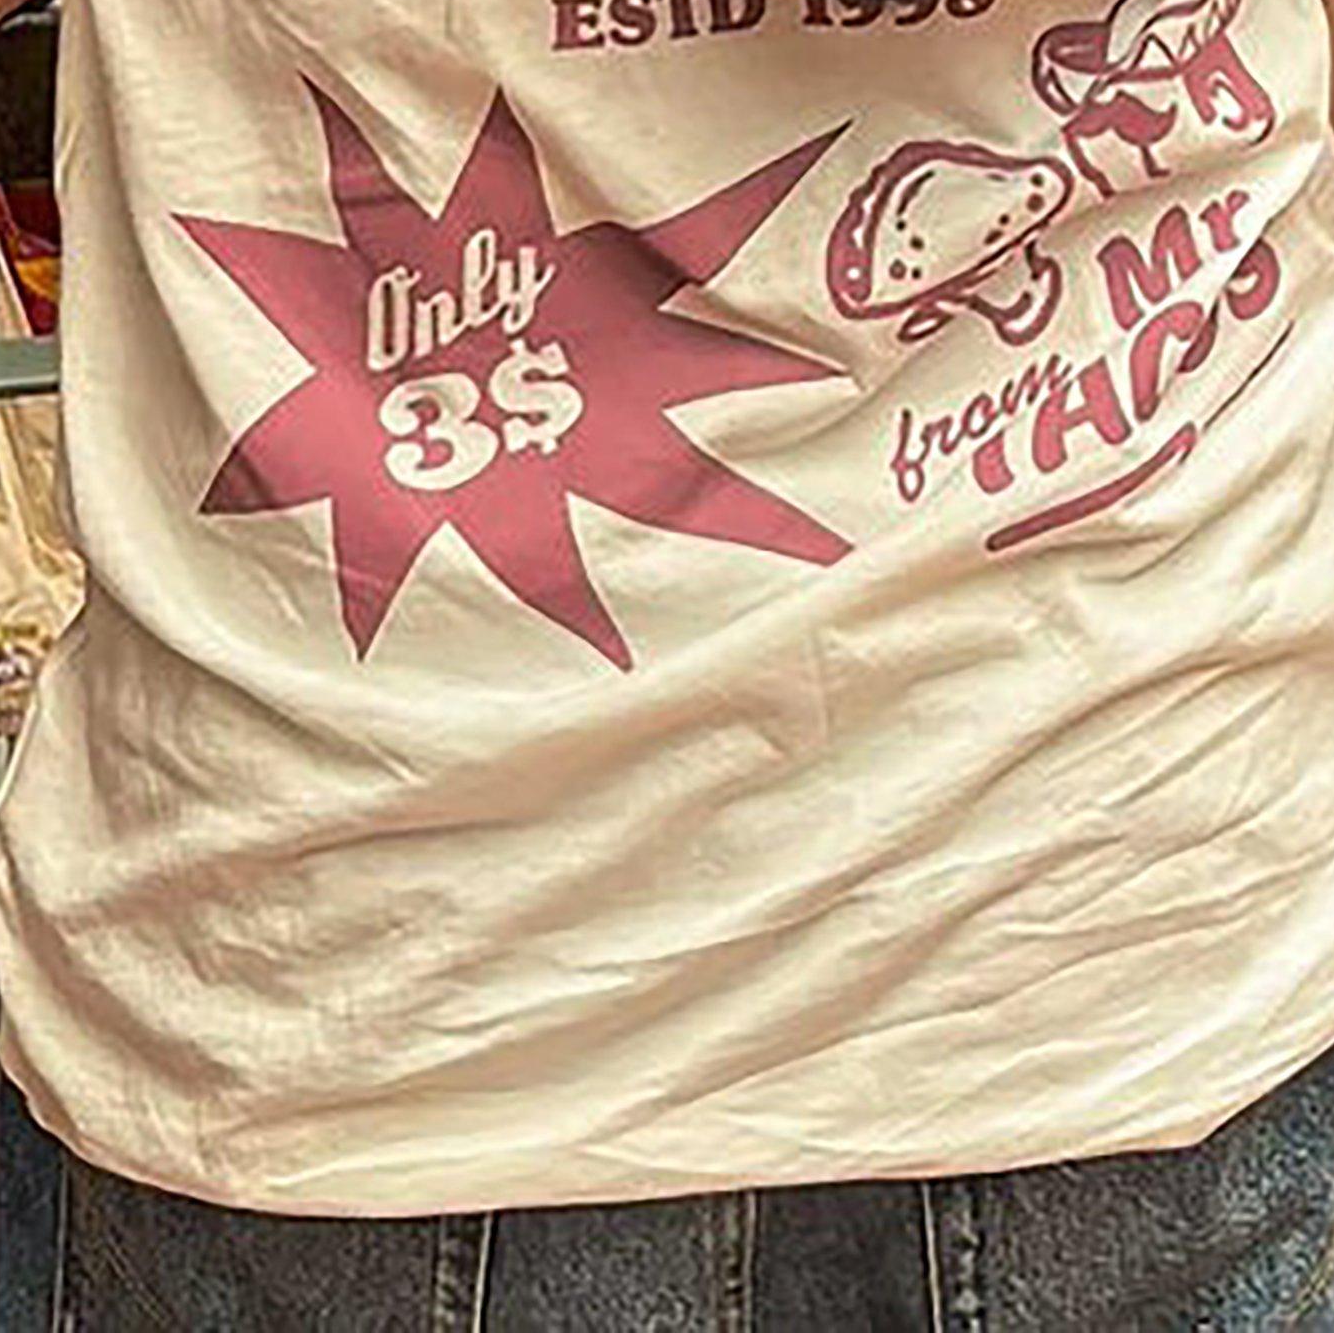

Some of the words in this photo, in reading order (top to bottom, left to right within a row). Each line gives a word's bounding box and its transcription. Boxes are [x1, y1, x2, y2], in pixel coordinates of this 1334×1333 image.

[368, 229, 556, 370] Only
[891, 354, 1073, 502] from
[1097, 190, 1250, 331] Mr
[379, 338, 584, 490] 3$
